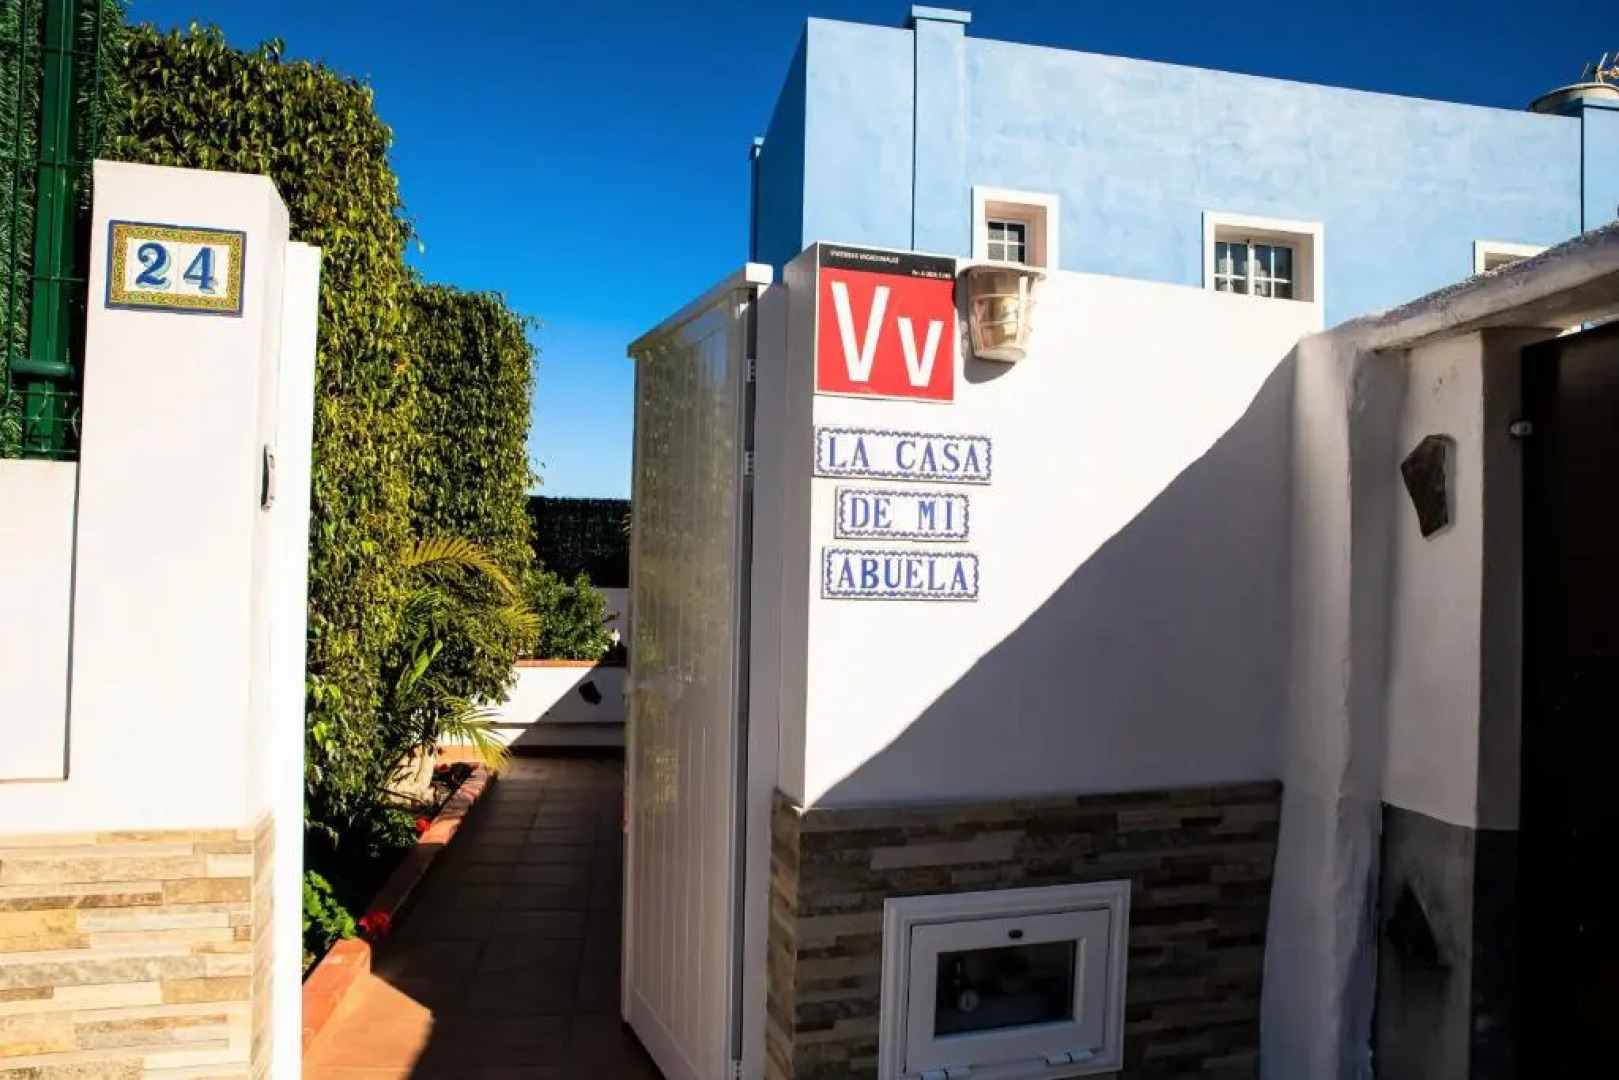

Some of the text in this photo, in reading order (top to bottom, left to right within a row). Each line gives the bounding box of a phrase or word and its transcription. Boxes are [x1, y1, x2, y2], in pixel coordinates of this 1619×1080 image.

[136, 242, 217, 294] 24
[828, 436, 981, 473] LA CASA
[850, 497, 955, 531] DE MI
[837, 557, 969, 592] ABUELA
